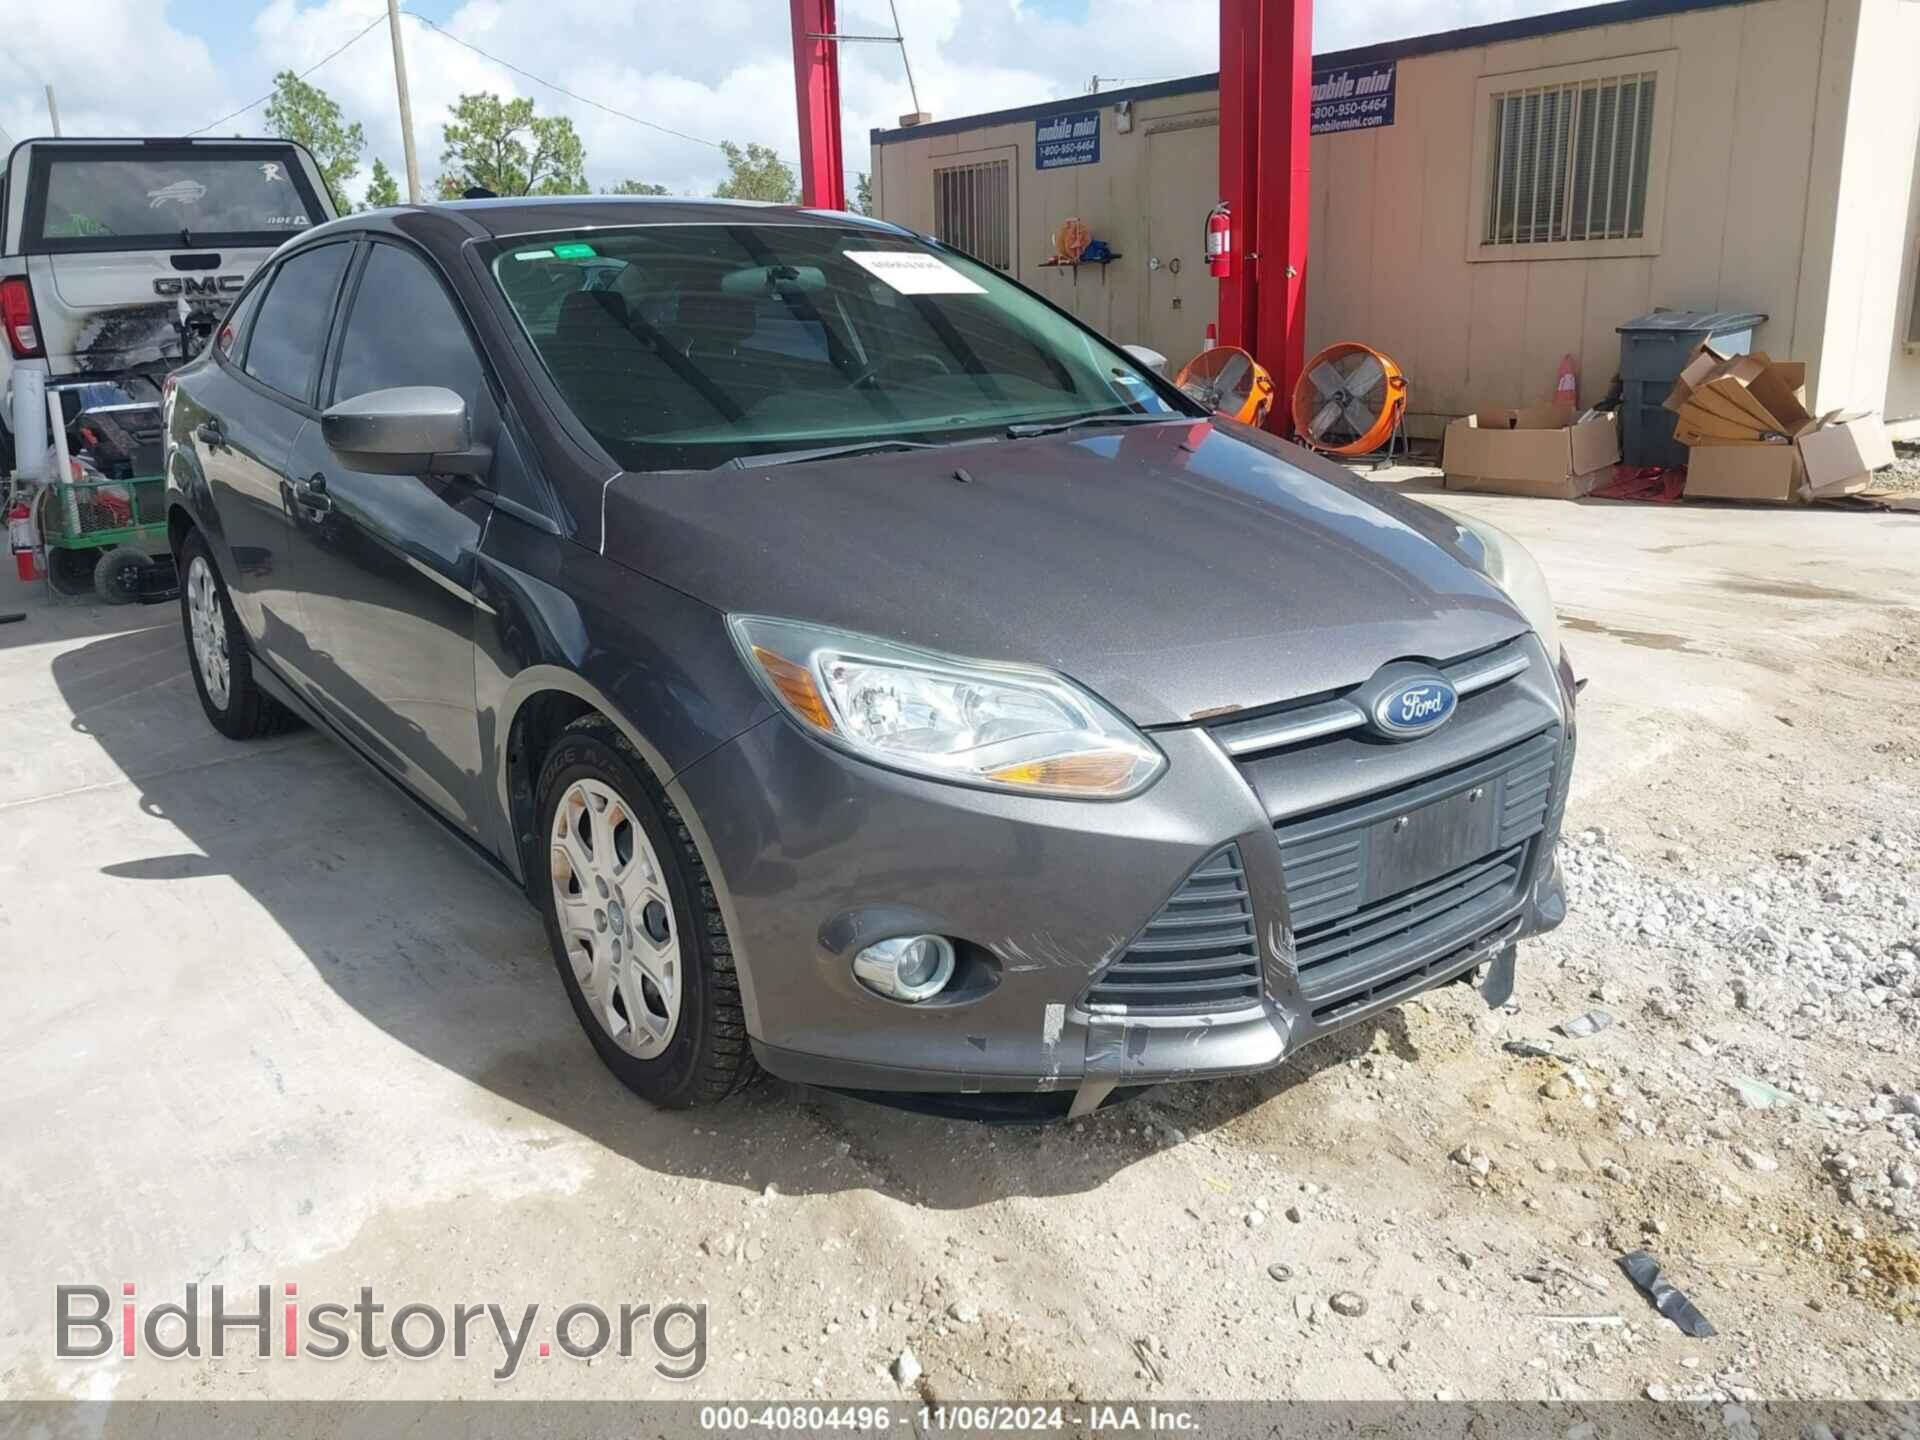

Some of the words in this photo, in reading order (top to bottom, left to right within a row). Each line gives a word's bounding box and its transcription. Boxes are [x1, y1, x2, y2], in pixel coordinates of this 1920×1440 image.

[1355, 68, 1393, 95] mini
[1312, 97, 1388, 119] -800-950-6464
[1038, 117, 1073, 142] mobile
[1073, 116, 1098, 137] mini
[153, 275, 244, 296] GMC
[1402, 688, 1442, 721] Ford
